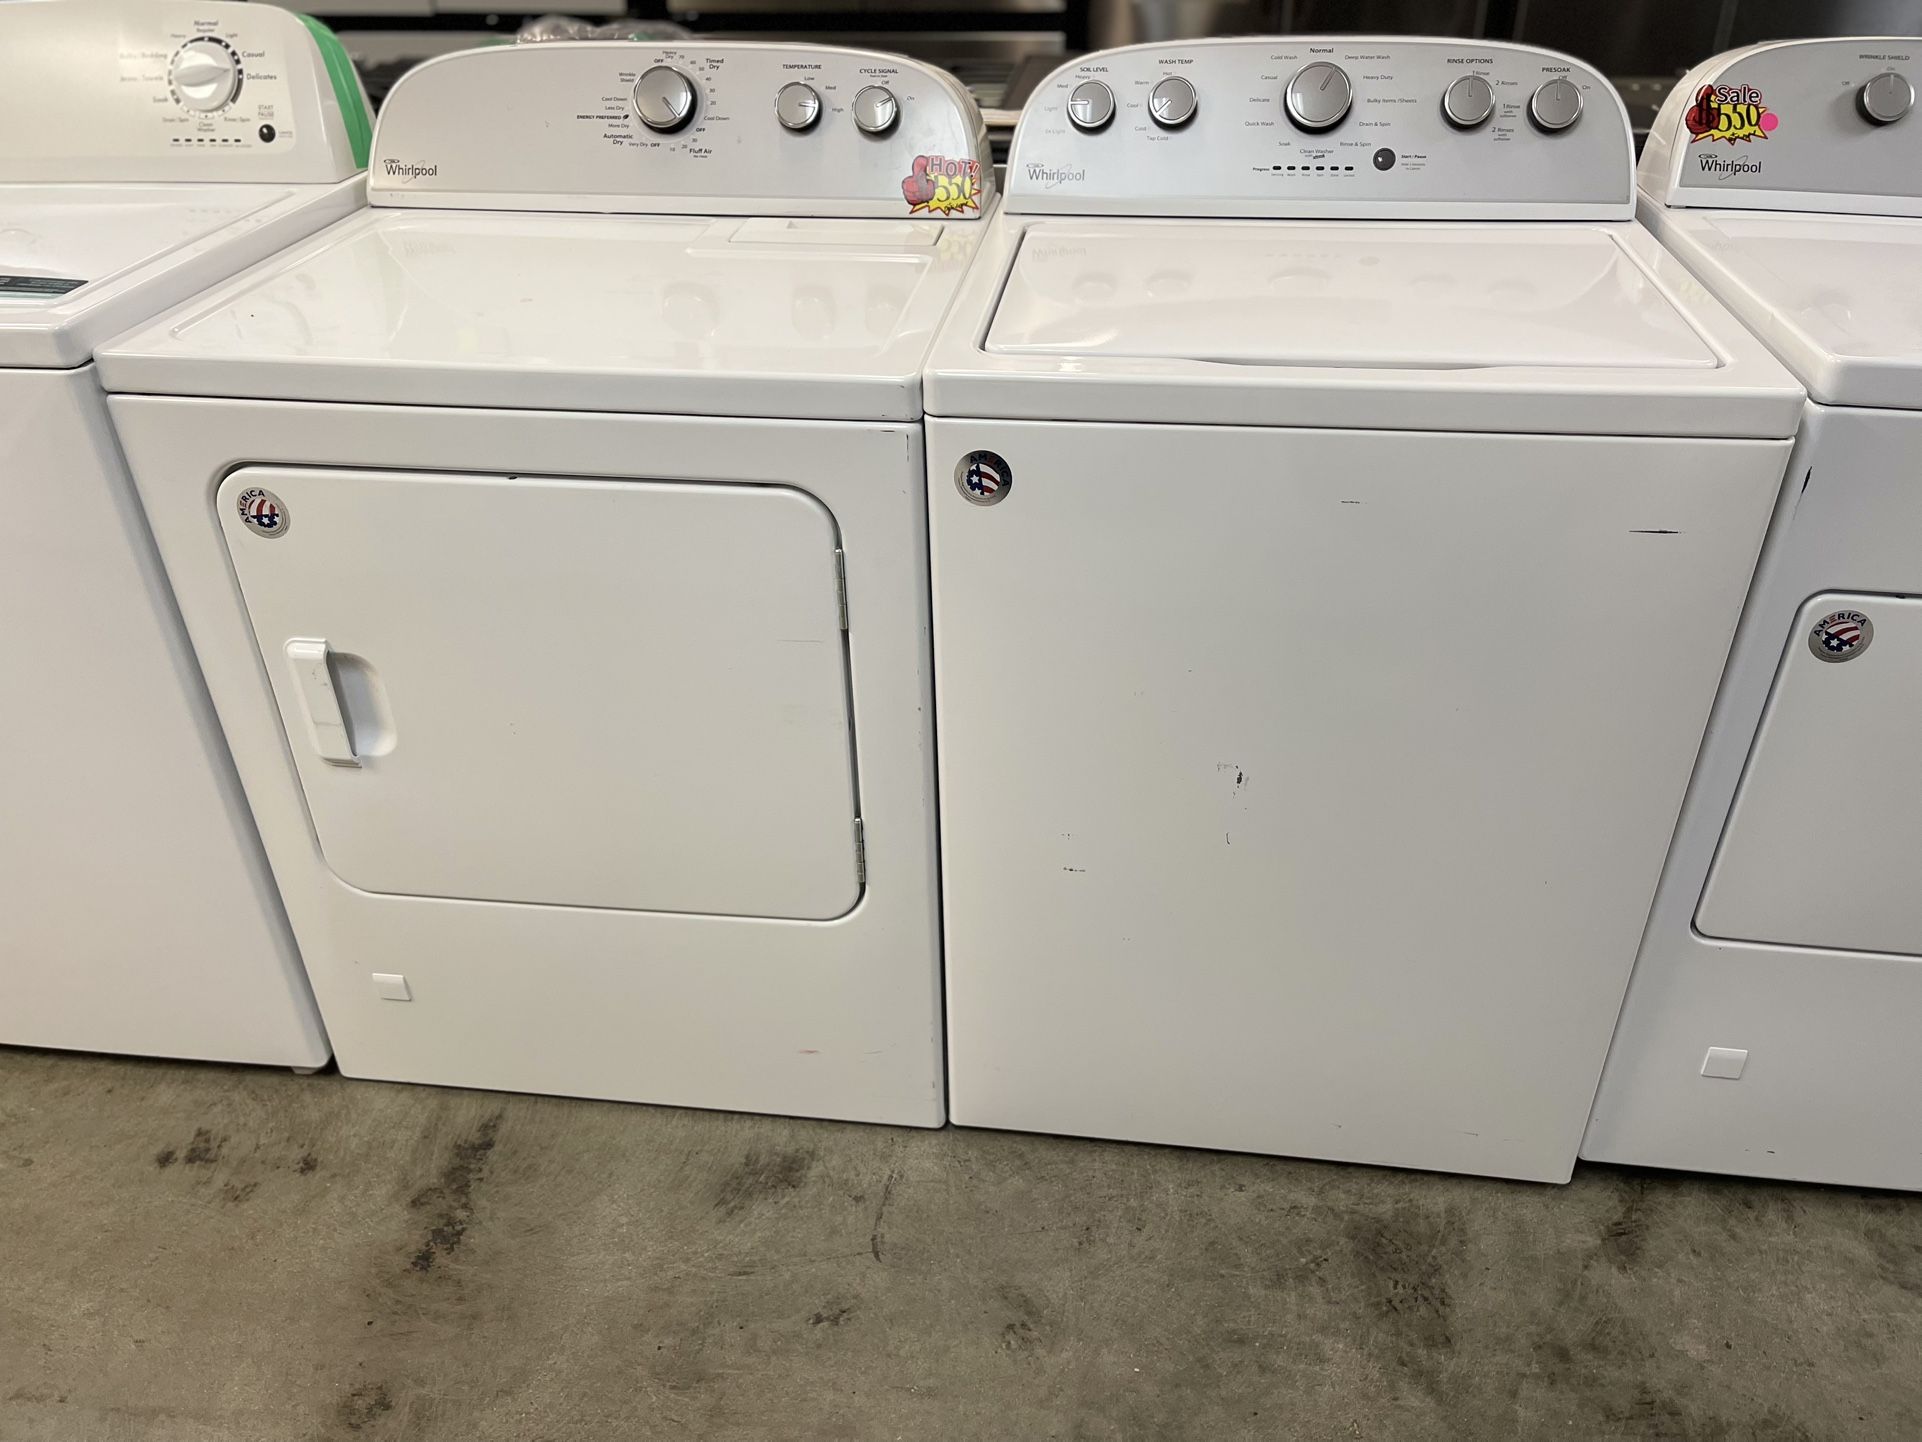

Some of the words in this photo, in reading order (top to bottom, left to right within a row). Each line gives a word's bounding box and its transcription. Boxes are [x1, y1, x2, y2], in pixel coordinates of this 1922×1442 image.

[1717, 86, 1760, 103] Sale
[385, 164, 438, 179] Whirlpool
[930, 156, 979, 177] HOT!
[1700, 159, 1761, 176] Whirlpool
[1028, 168, 1085, 184] Whirlpool
[240, 490, 265, 523] AMERICA
[1814, 613, 1866, 636] AMERICA
